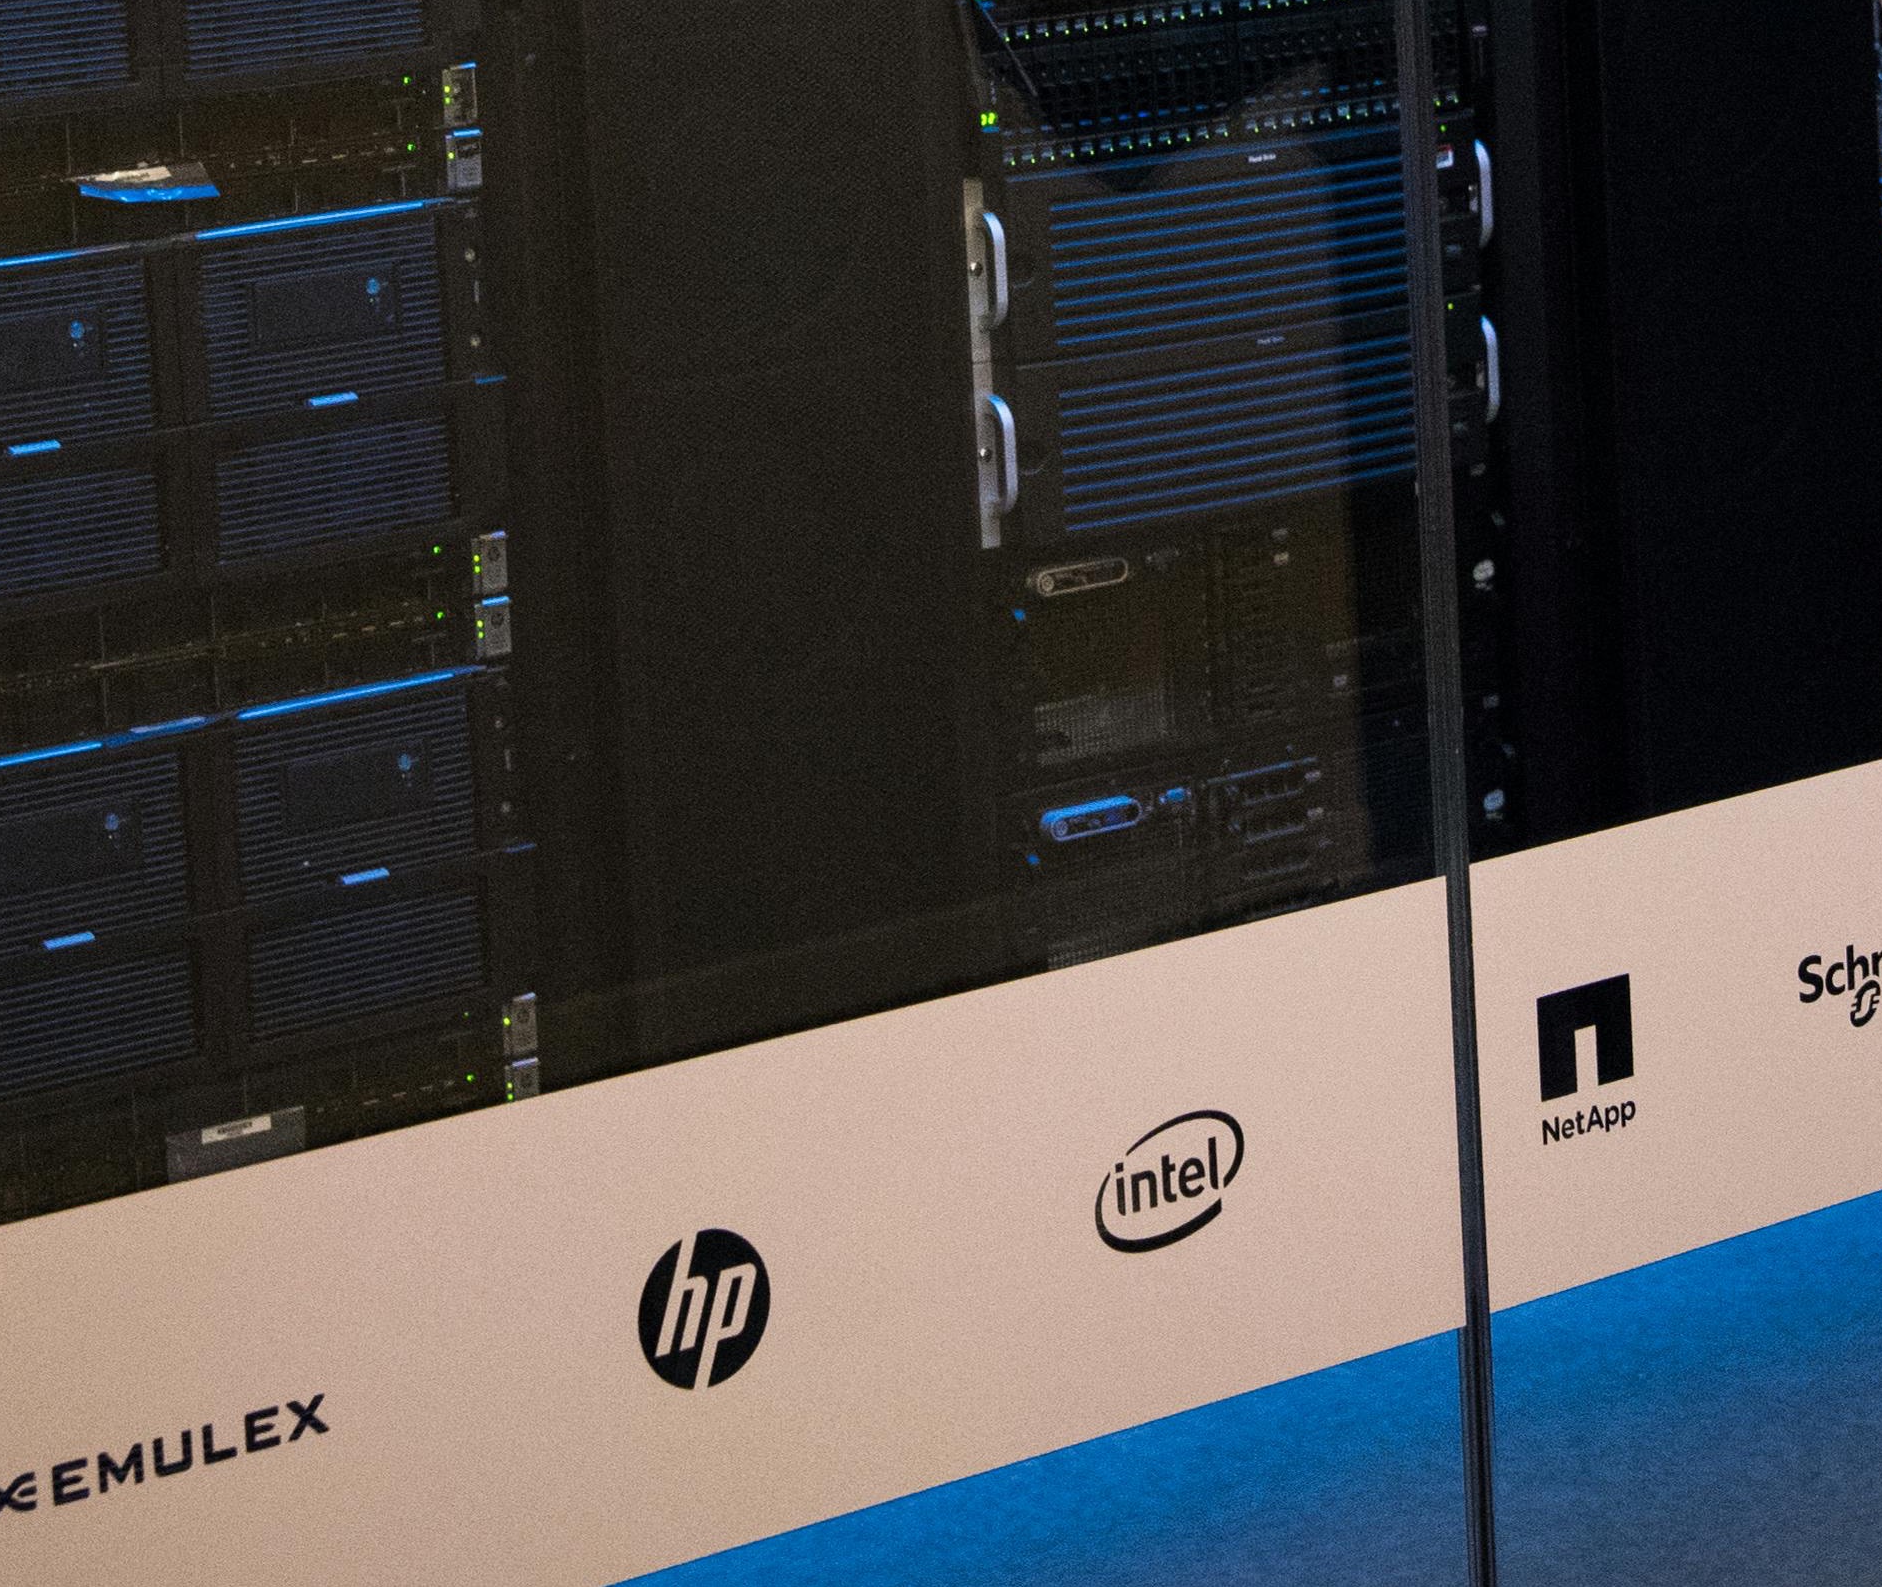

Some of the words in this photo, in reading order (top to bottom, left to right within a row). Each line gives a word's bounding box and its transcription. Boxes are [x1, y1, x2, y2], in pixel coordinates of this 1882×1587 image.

[1541, 1100, 1636, 1145] NetApp
[1115, 1136, 1220, 1217] intel
[649, 1228, 764, 1389] hp
[51, 1394, 330, 1507] EMULEX
